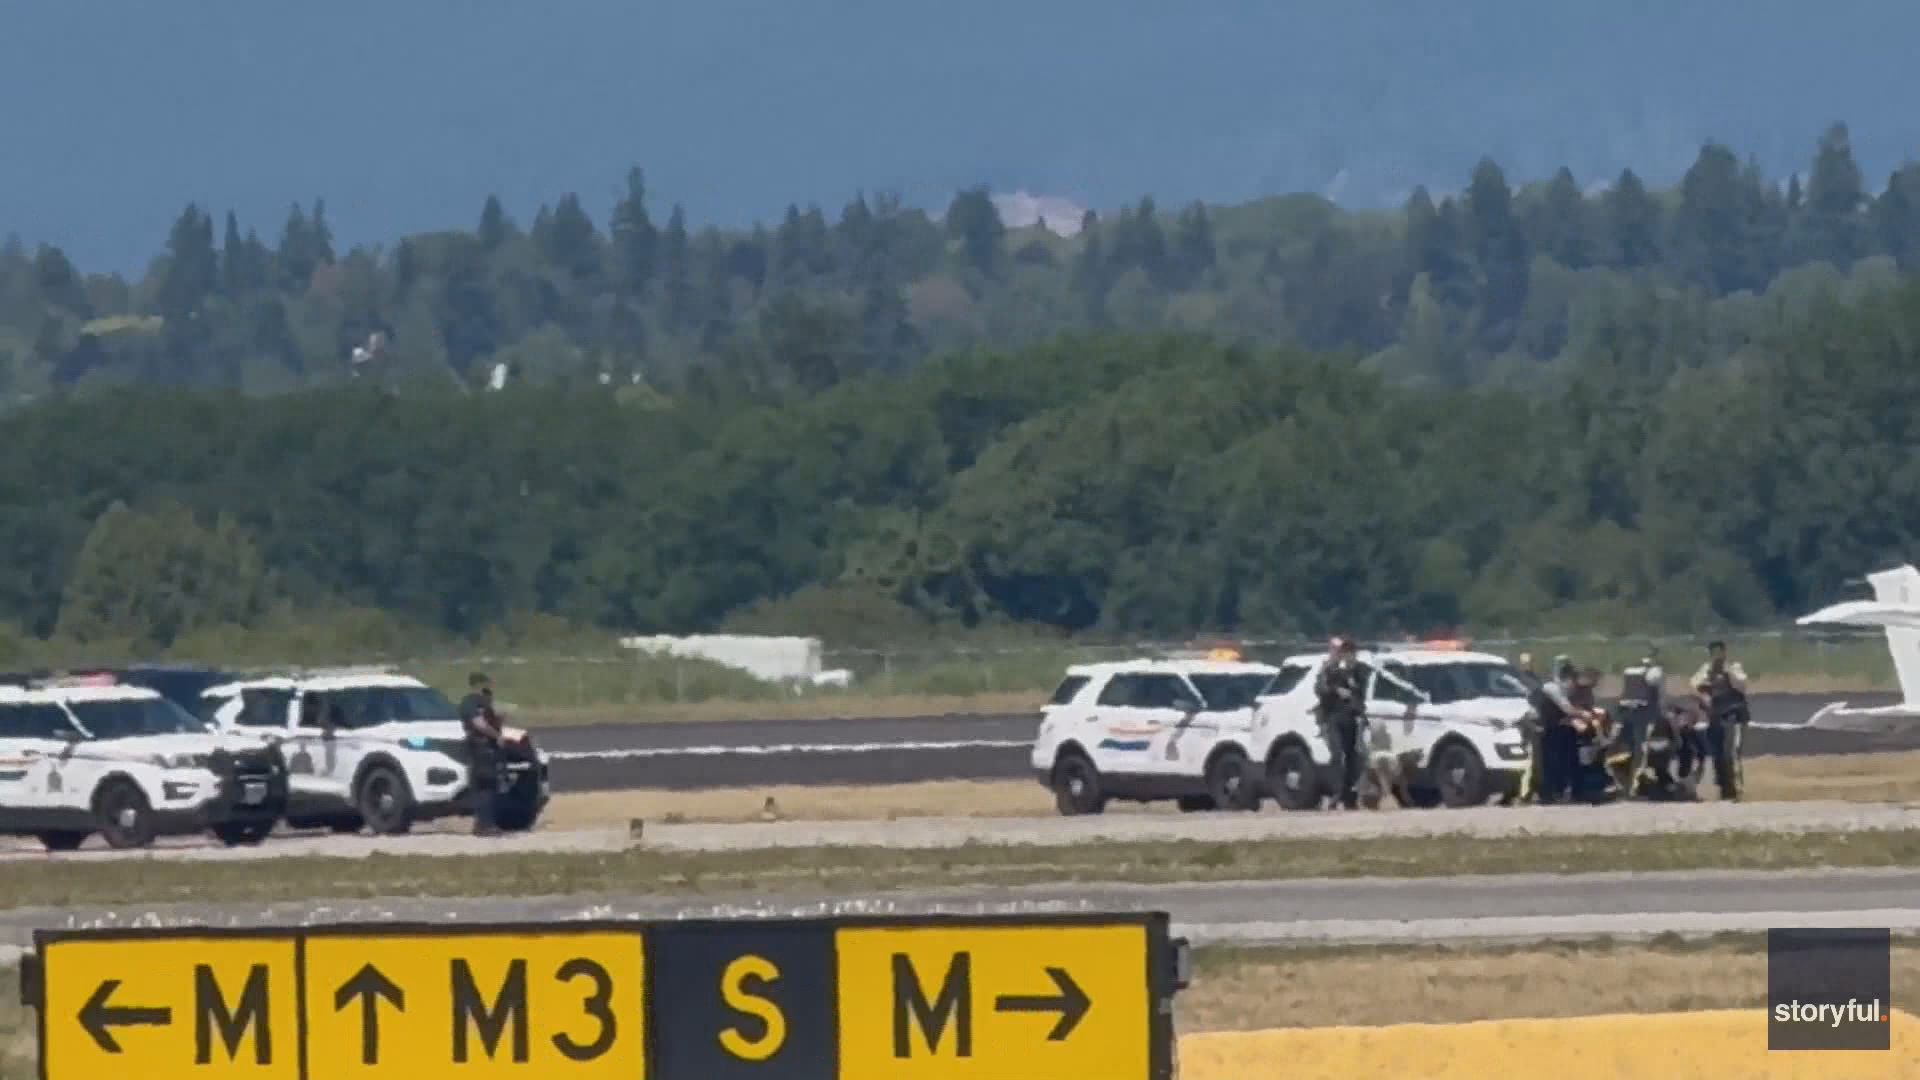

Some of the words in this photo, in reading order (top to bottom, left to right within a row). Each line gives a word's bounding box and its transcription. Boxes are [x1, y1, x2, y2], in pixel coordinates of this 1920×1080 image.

[194, 963, 272, 1065] M
[450, 957, 618, 1063] M3
[718, 954, 787, 1061] S
[891, 951, 972, 1059] M
